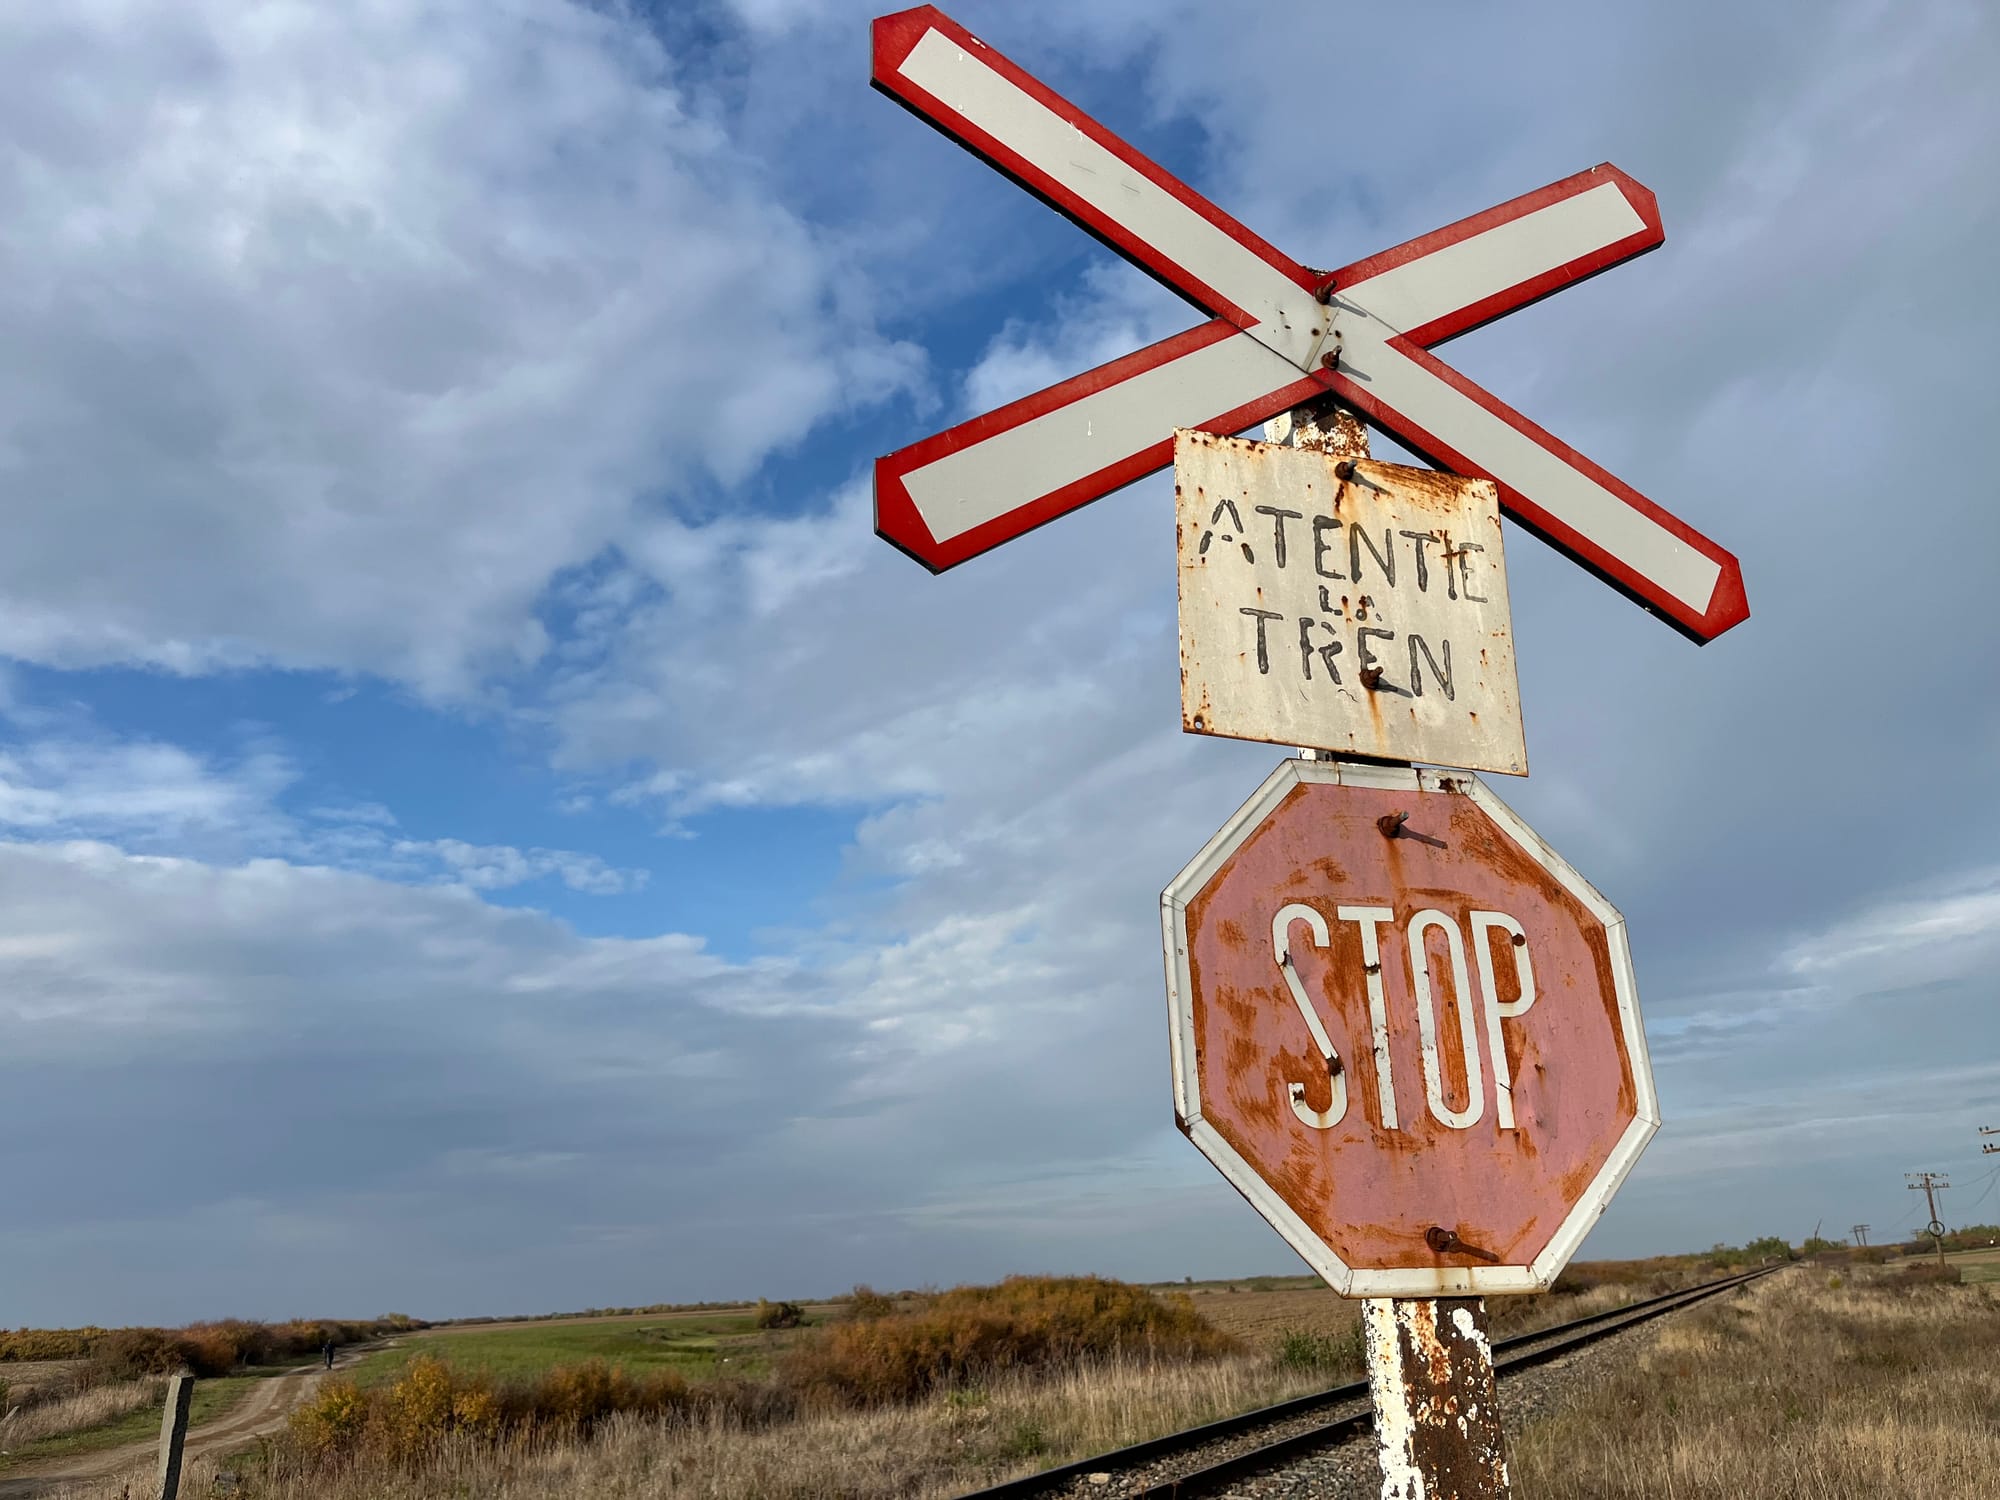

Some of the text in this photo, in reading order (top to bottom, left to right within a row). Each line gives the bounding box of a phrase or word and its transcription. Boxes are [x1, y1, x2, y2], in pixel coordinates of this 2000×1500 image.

[1199, 499, 1488, 603] ATENTIE
[1239, 607, 1455, 701] TREN
[1272, 903, 1536, 1129] STOP
